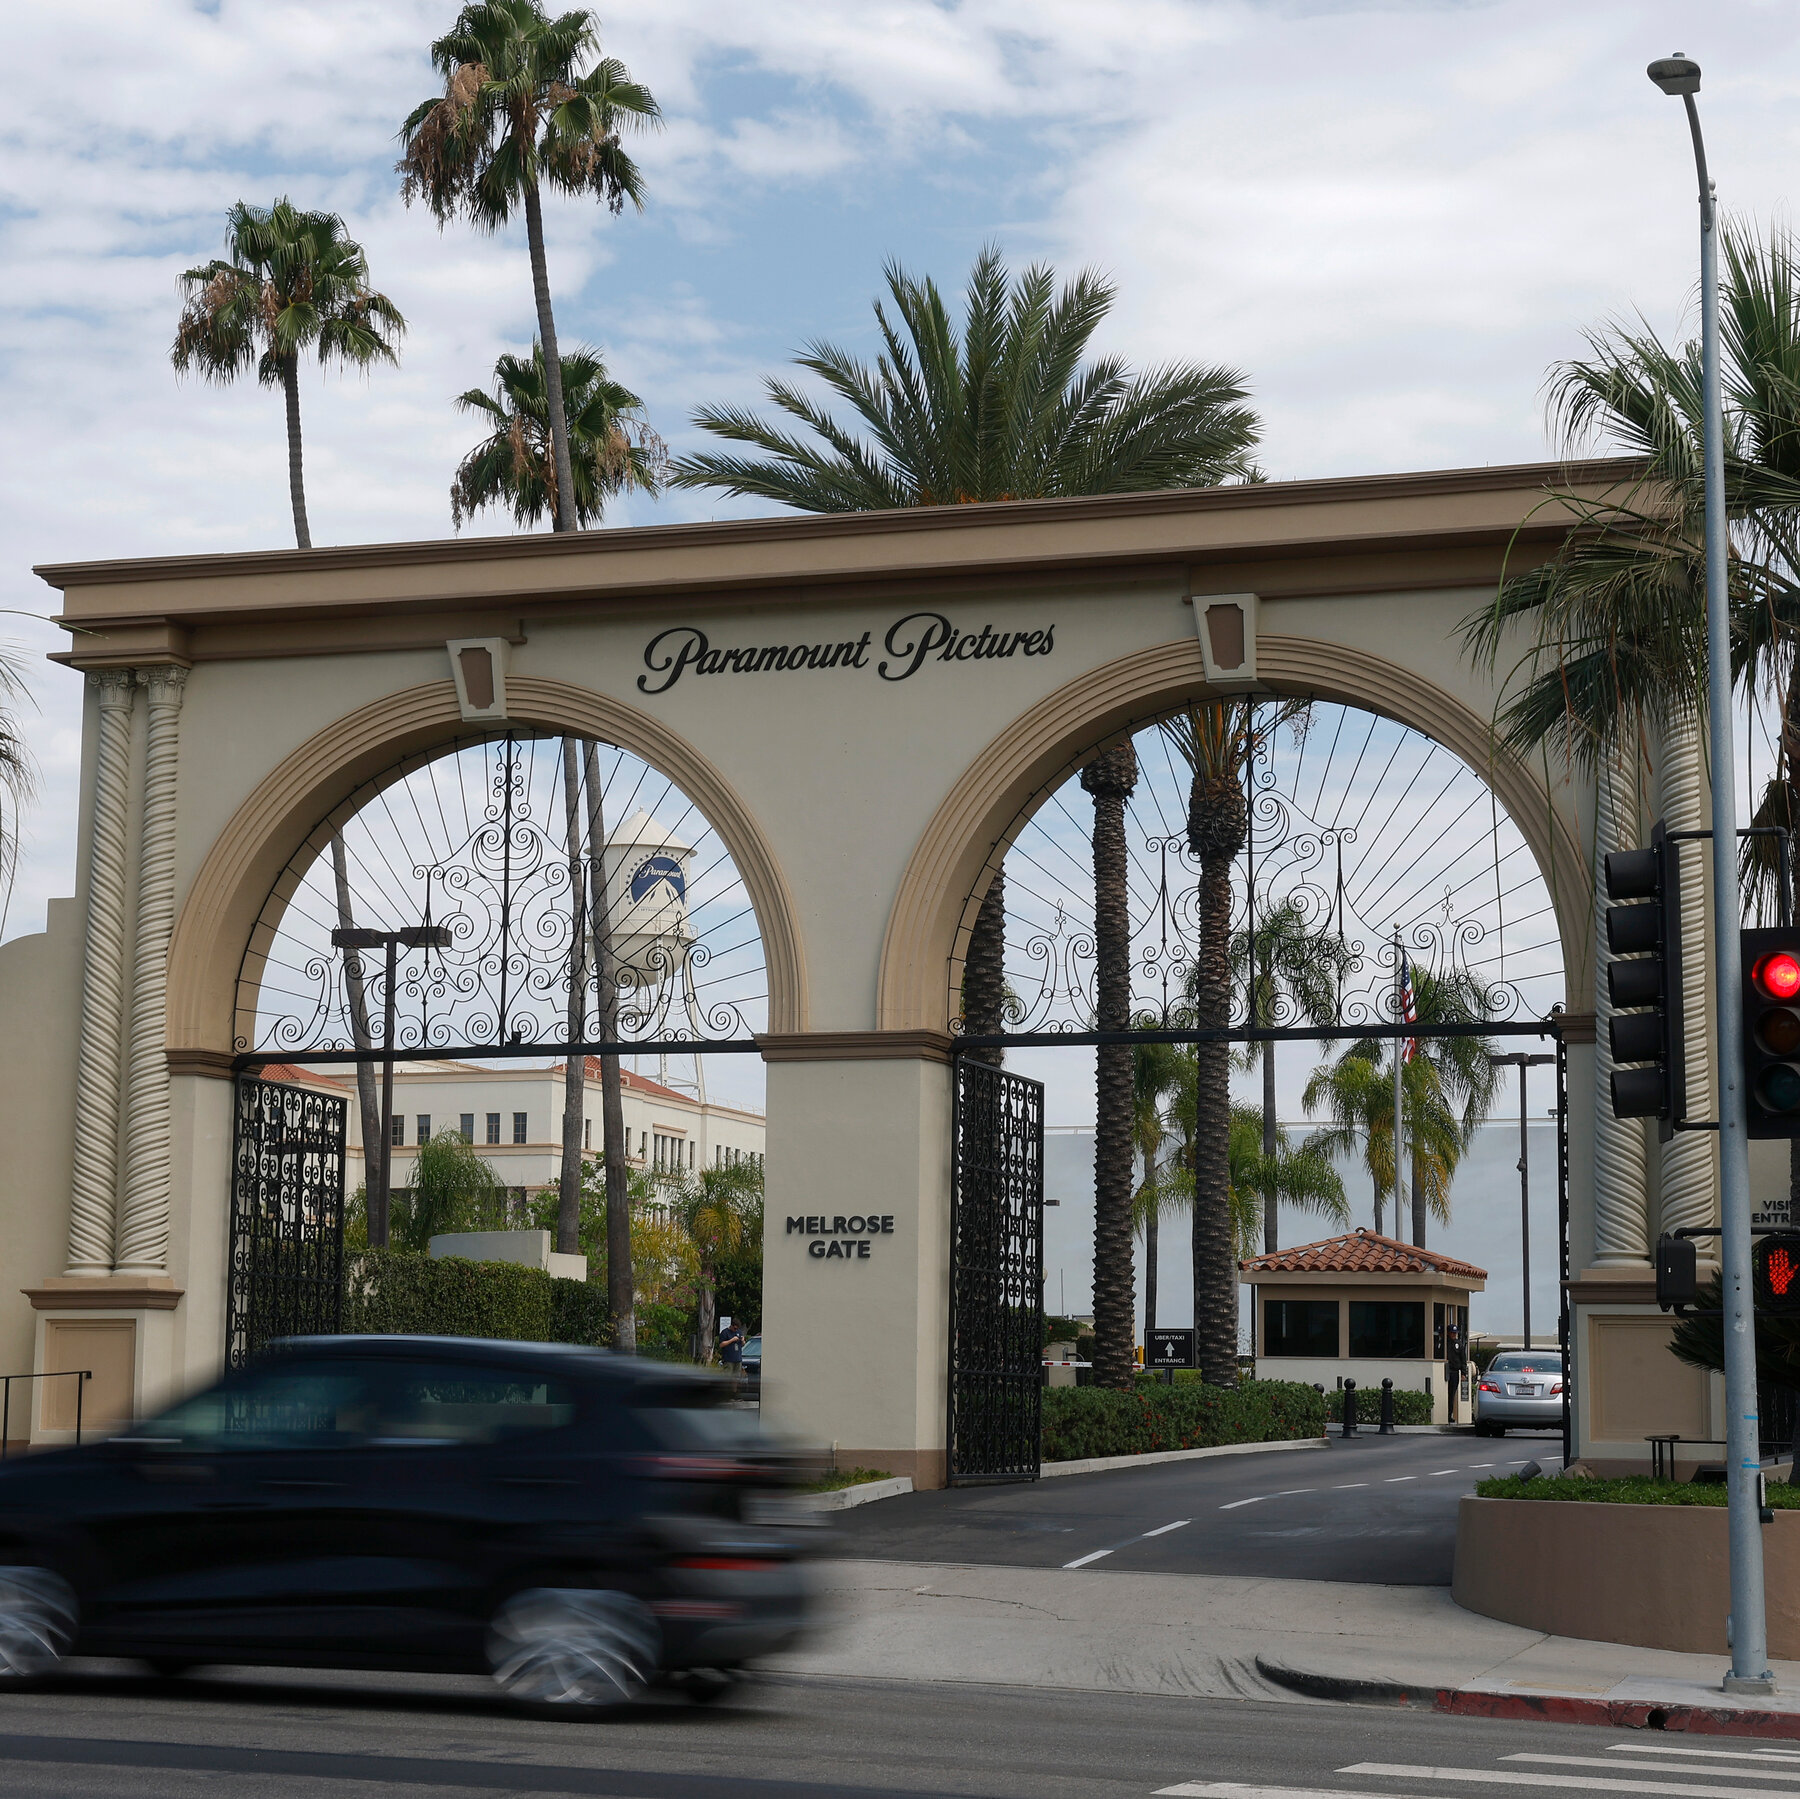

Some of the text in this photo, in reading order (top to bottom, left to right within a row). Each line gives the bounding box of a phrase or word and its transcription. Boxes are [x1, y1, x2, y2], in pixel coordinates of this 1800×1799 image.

[637, 612, 1055, 694] Paramount Pictures
[638, 864, 682, 879] Paramount
[1763, 1200, 1790, 1211] VISI
[786, 1215, 895, 1234] MELROSE
[1752, 1212, 1790, 1223] ENTR
[808, 1240, 871, 1259] GATE
